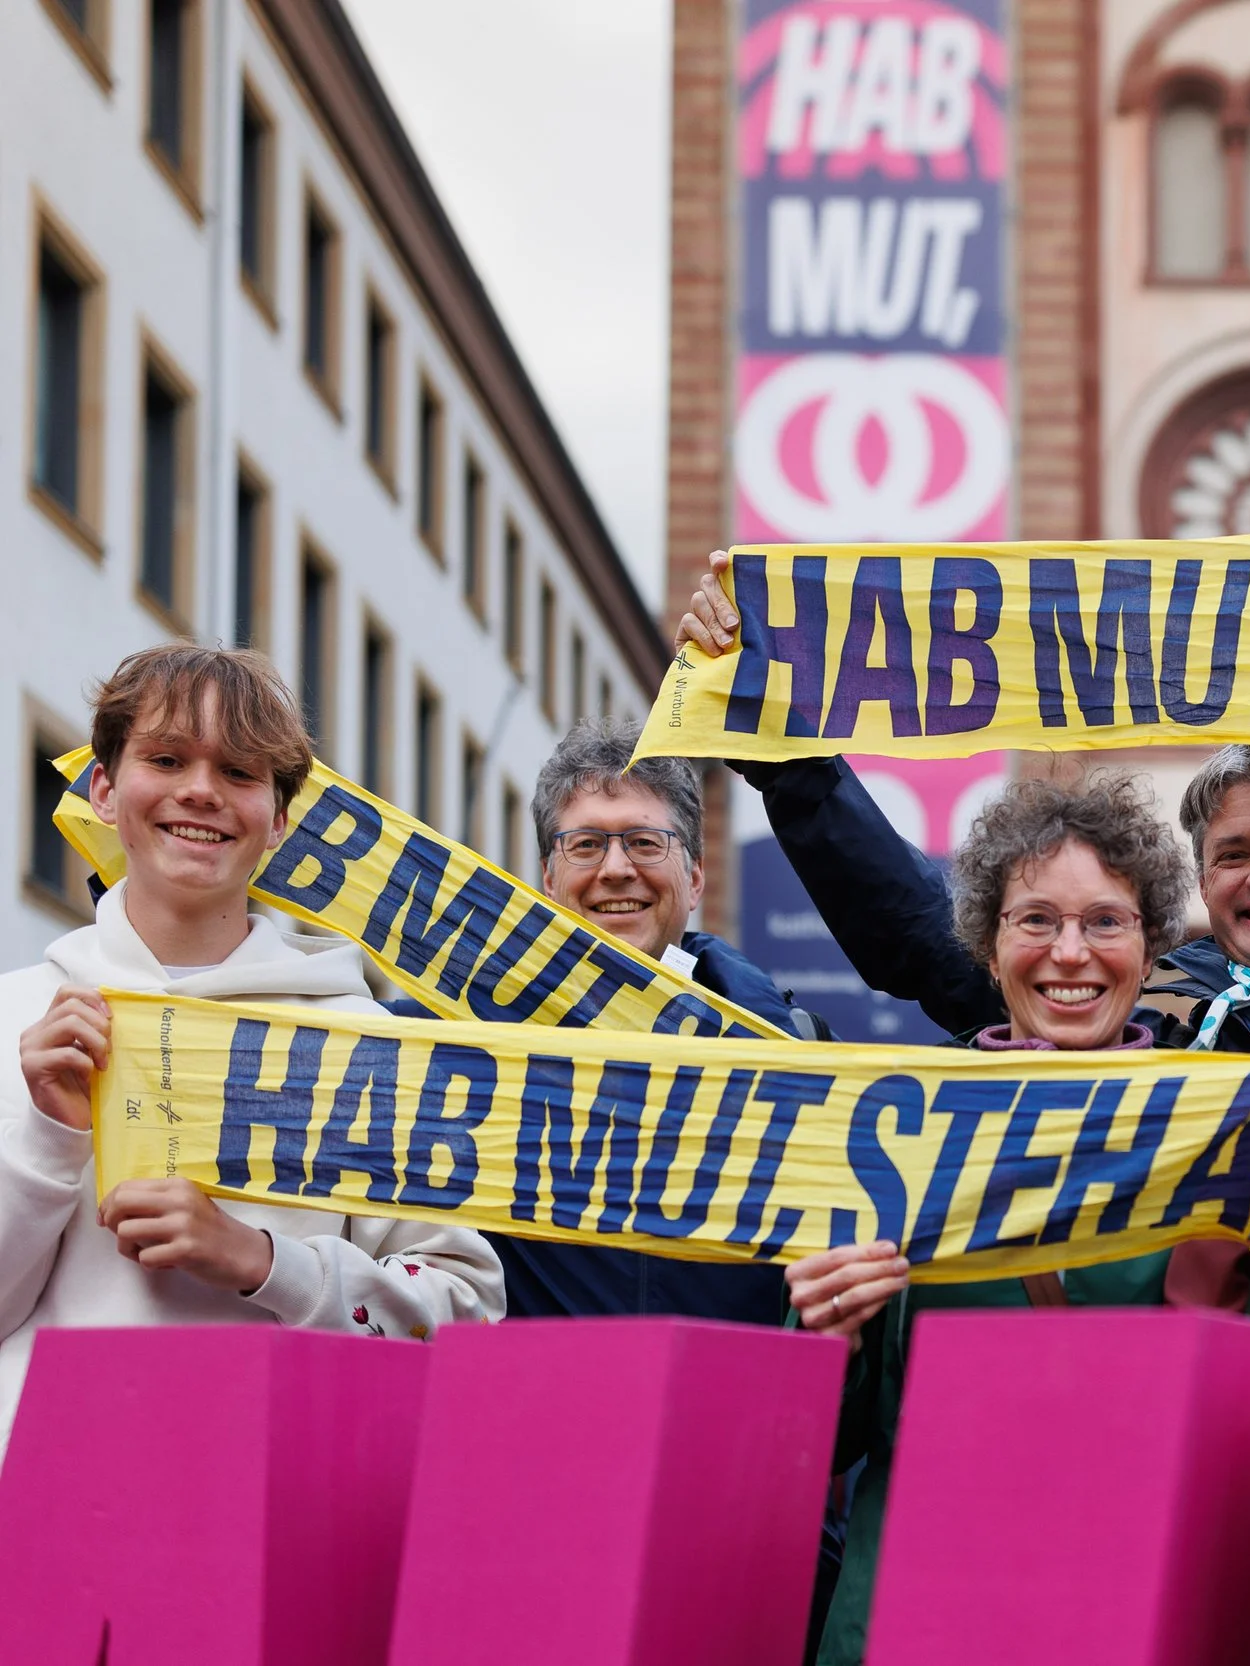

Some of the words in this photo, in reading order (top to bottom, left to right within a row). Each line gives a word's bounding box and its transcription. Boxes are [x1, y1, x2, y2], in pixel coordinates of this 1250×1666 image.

[767, 14, 984, 155] HAB
[768, 197, 983, 349] MUT,
[724, 554, 1004, 739] HAB
[160, 1006, 175, 1091] Katholikentag
[216, 1019, 498, 1211] HAB
[510, 1053, 835, 1262] MUT,
[828, 1073, 1188, 1265] STEH
